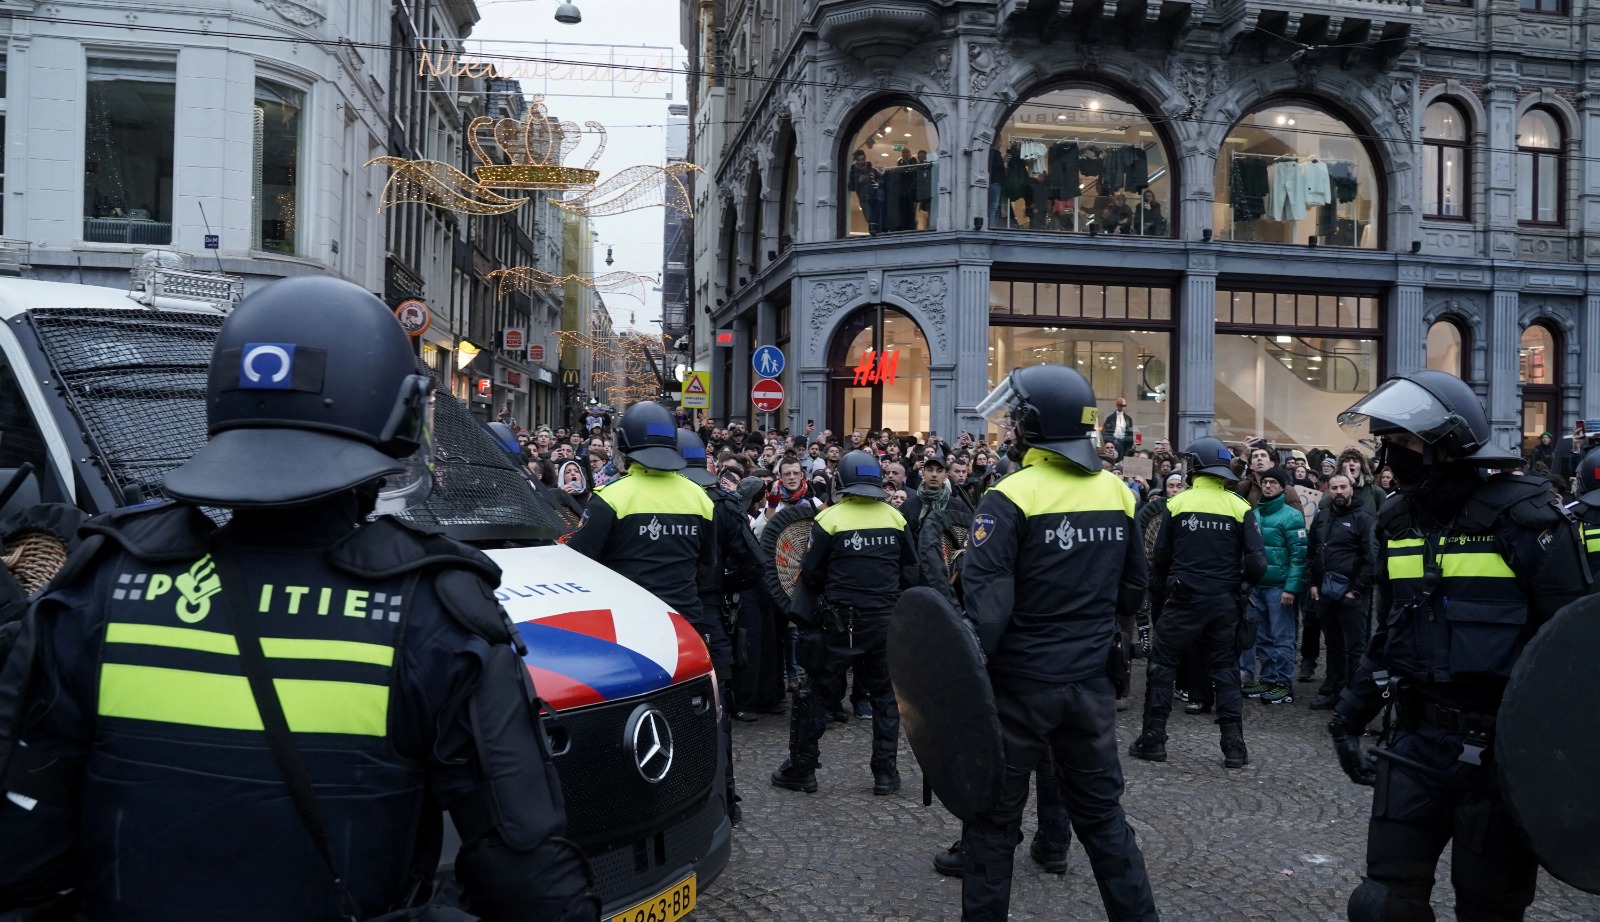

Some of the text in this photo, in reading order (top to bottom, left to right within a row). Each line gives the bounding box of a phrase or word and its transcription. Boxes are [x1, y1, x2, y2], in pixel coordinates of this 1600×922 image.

[852, 350, 900, 386] H&M
[638, 515, 698, 541] POLITIE
[1045, 516, 1124, 550] POLITIE
[1181, 514, 1231, 531] POLITIE
[844, 531, 896, 550] POLITIE
[145, 553, 369, 623] POITIE
[493, 582, 592, 602] OLITIE
